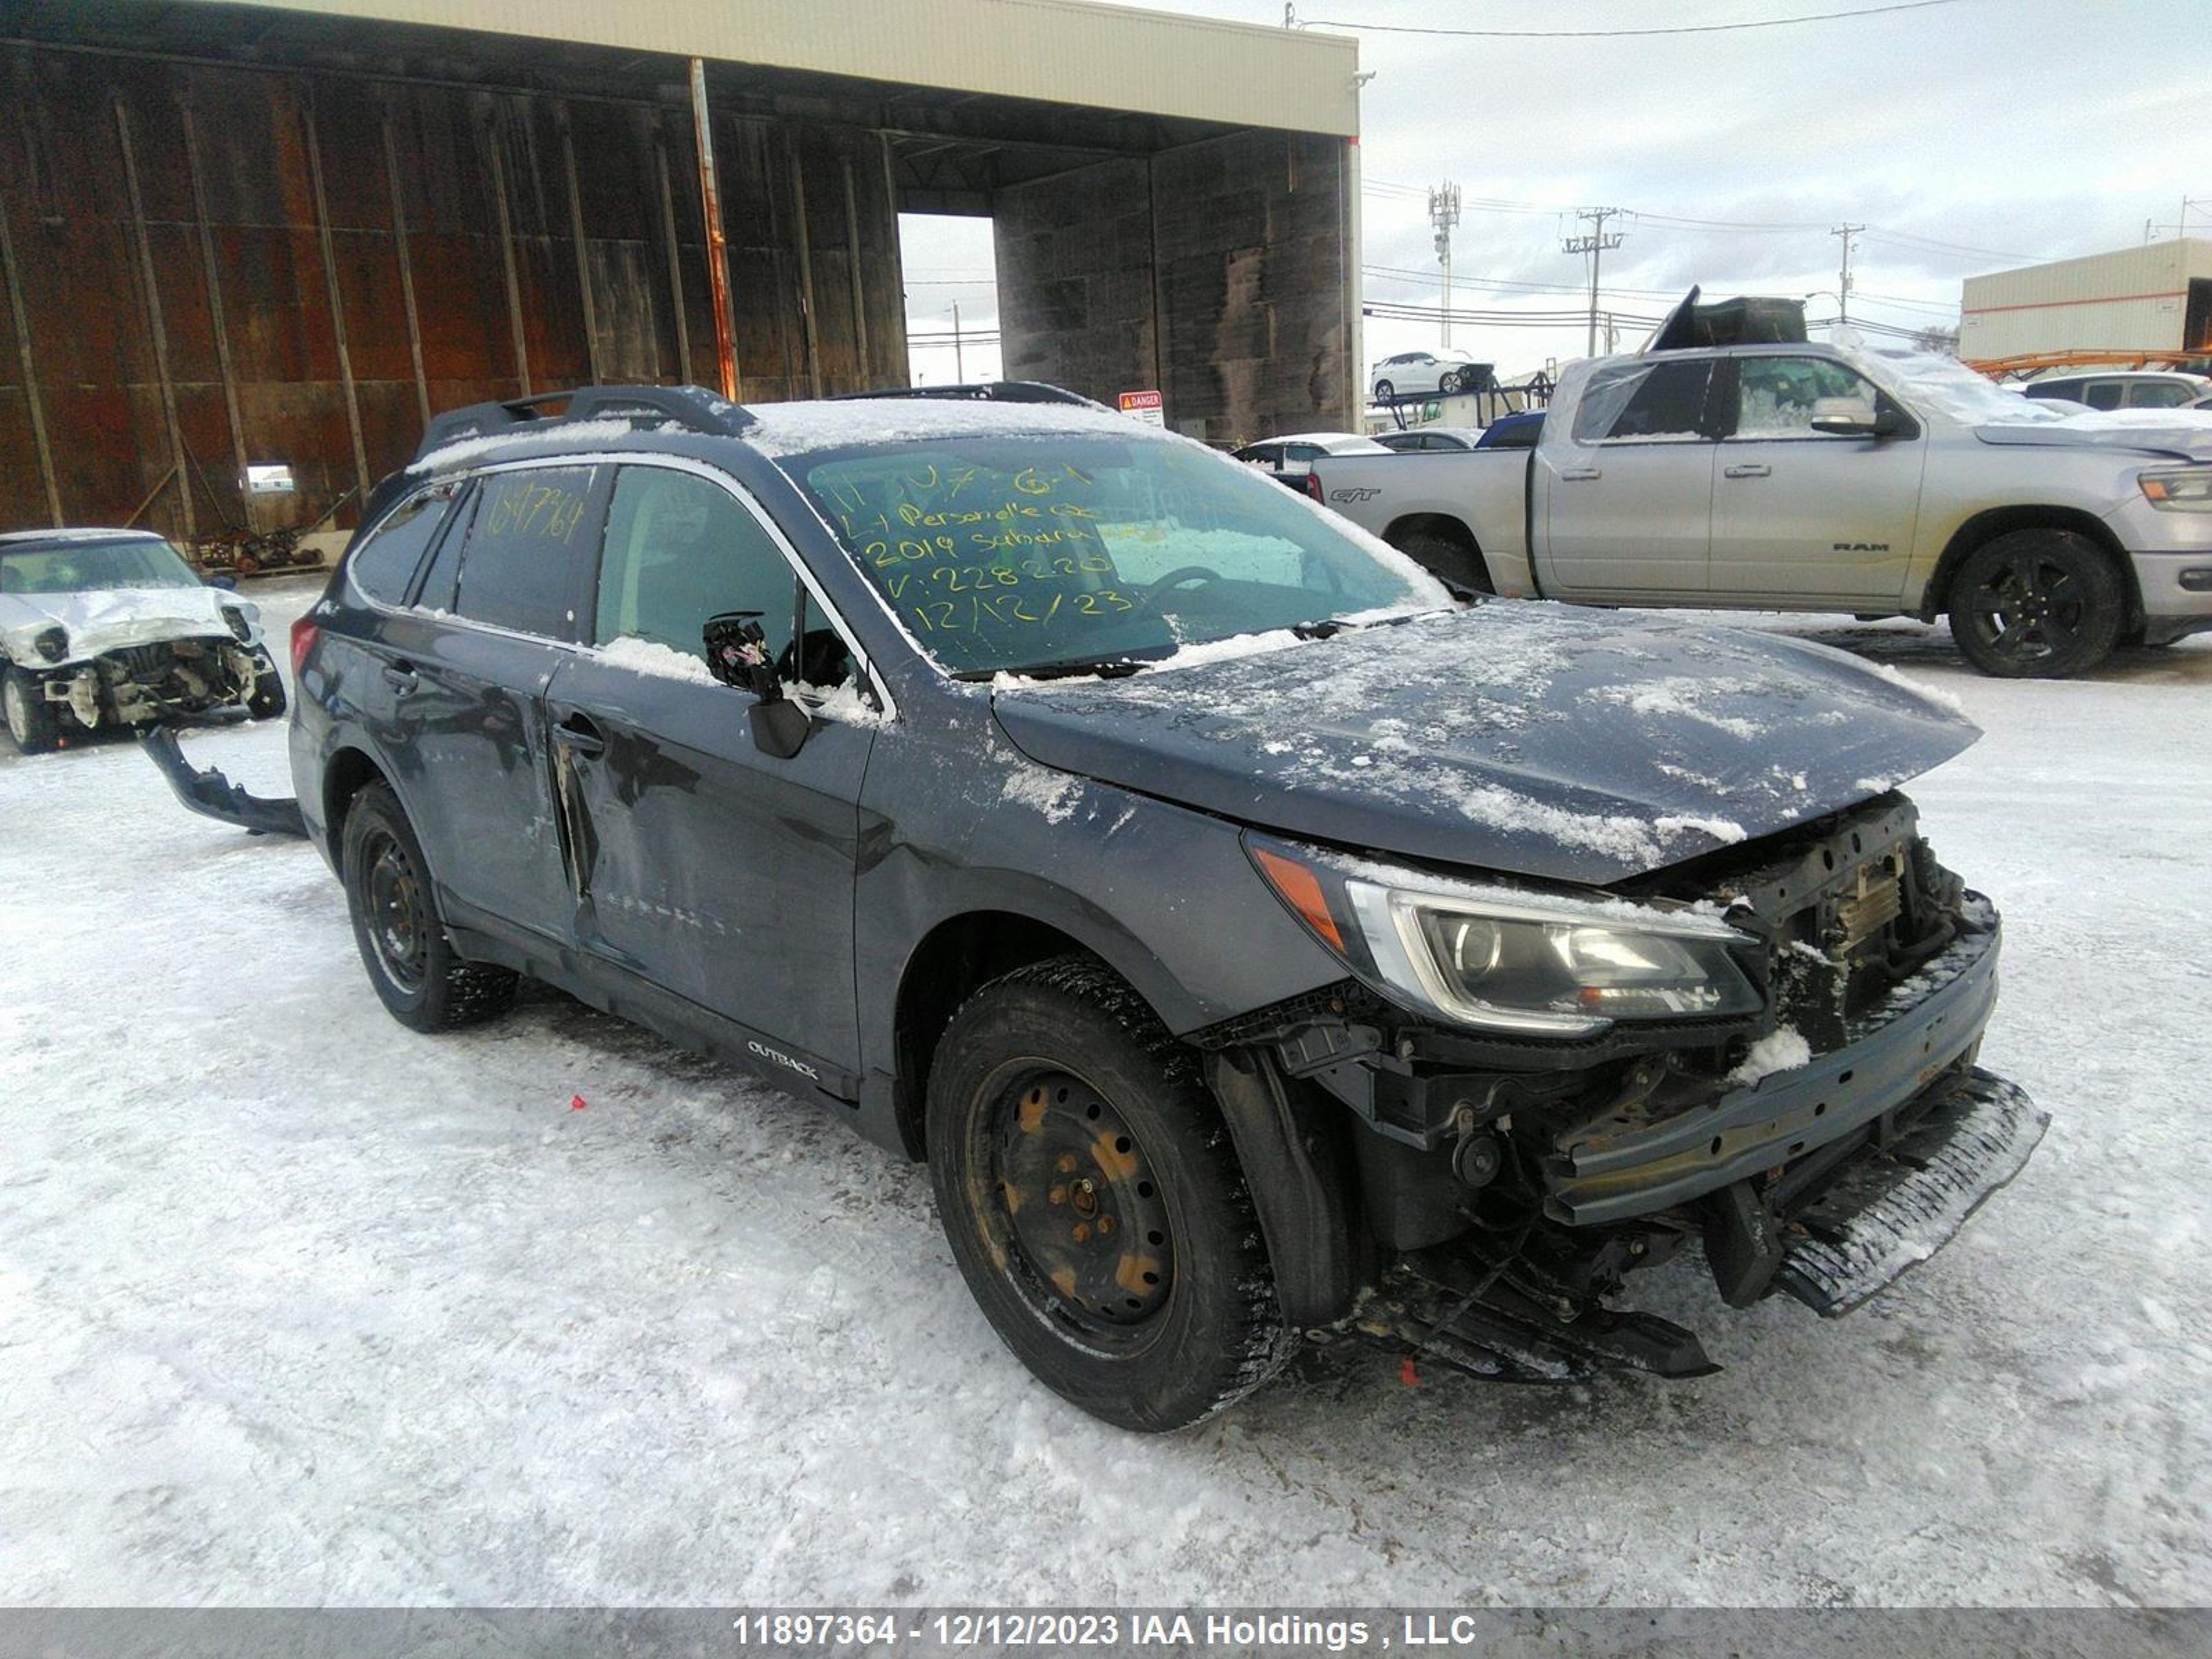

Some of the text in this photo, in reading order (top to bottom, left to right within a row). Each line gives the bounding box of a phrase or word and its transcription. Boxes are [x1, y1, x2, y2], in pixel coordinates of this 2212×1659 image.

[1132, 395, 1160, 408] DANGER
[865, 534, 959, 568] 2019
[1833, 543, 1890, 552] RAM
[747, 1040, 819, 1080] OUTBACK
